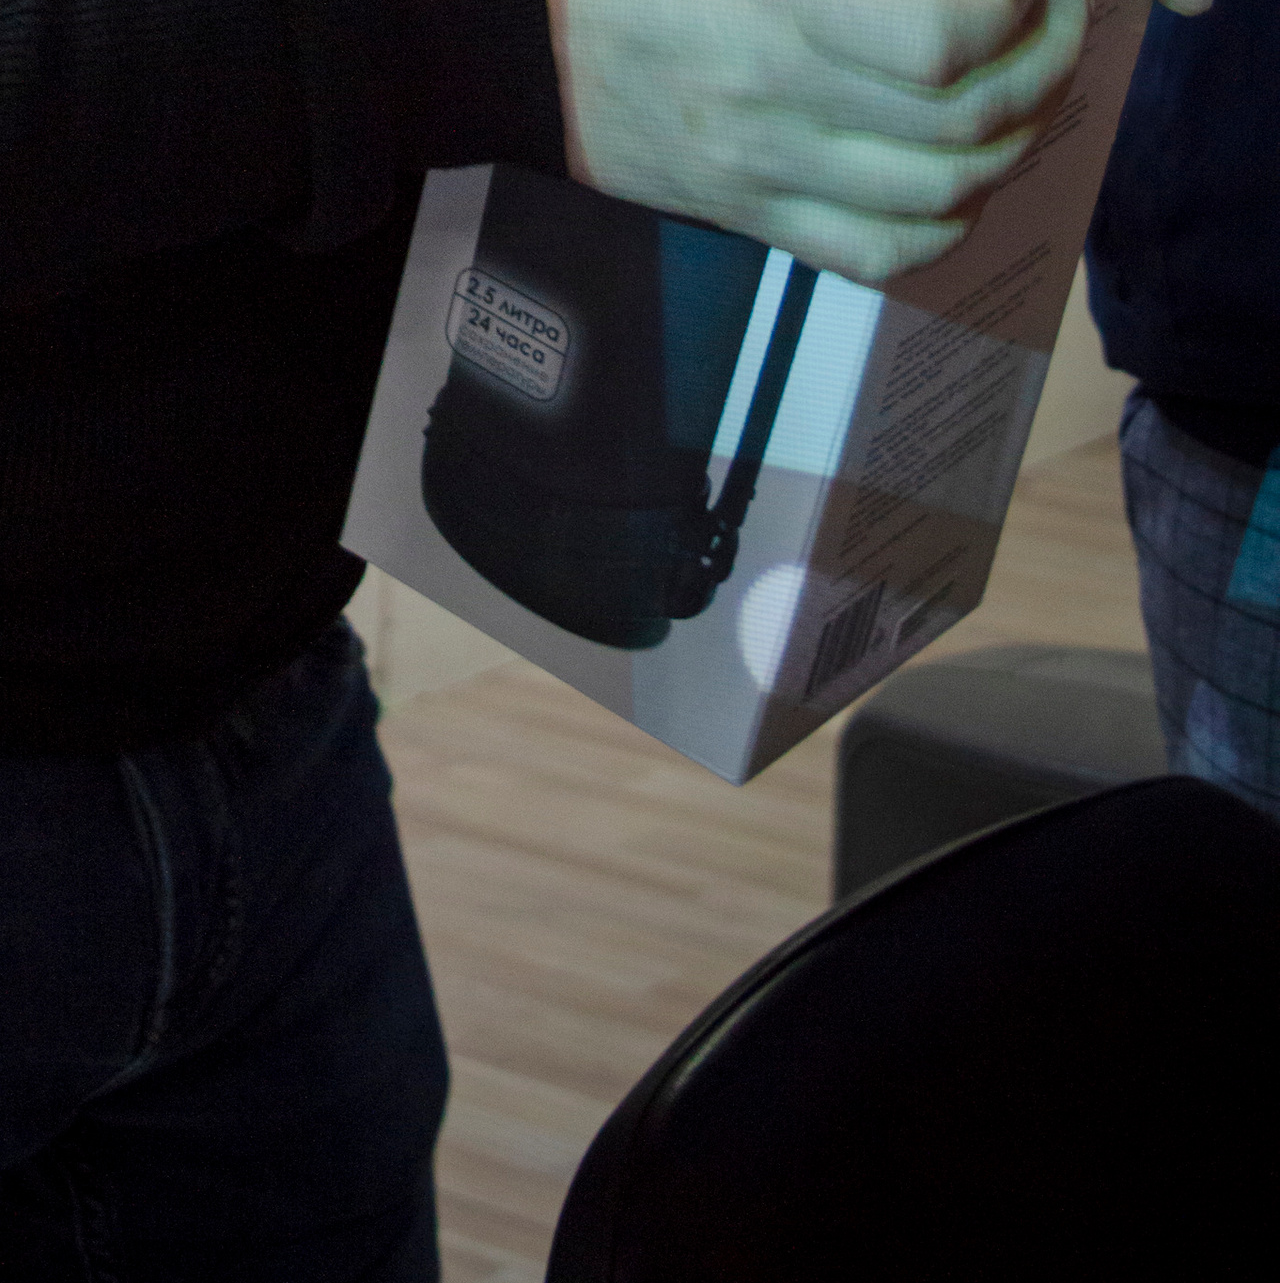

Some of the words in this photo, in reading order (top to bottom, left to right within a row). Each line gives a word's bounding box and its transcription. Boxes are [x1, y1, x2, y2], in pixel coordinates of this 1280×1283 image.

[468, 307, 490, 331] 24
[496, 326, 545, 364] часа
[499, 300, 559, 342] литра
